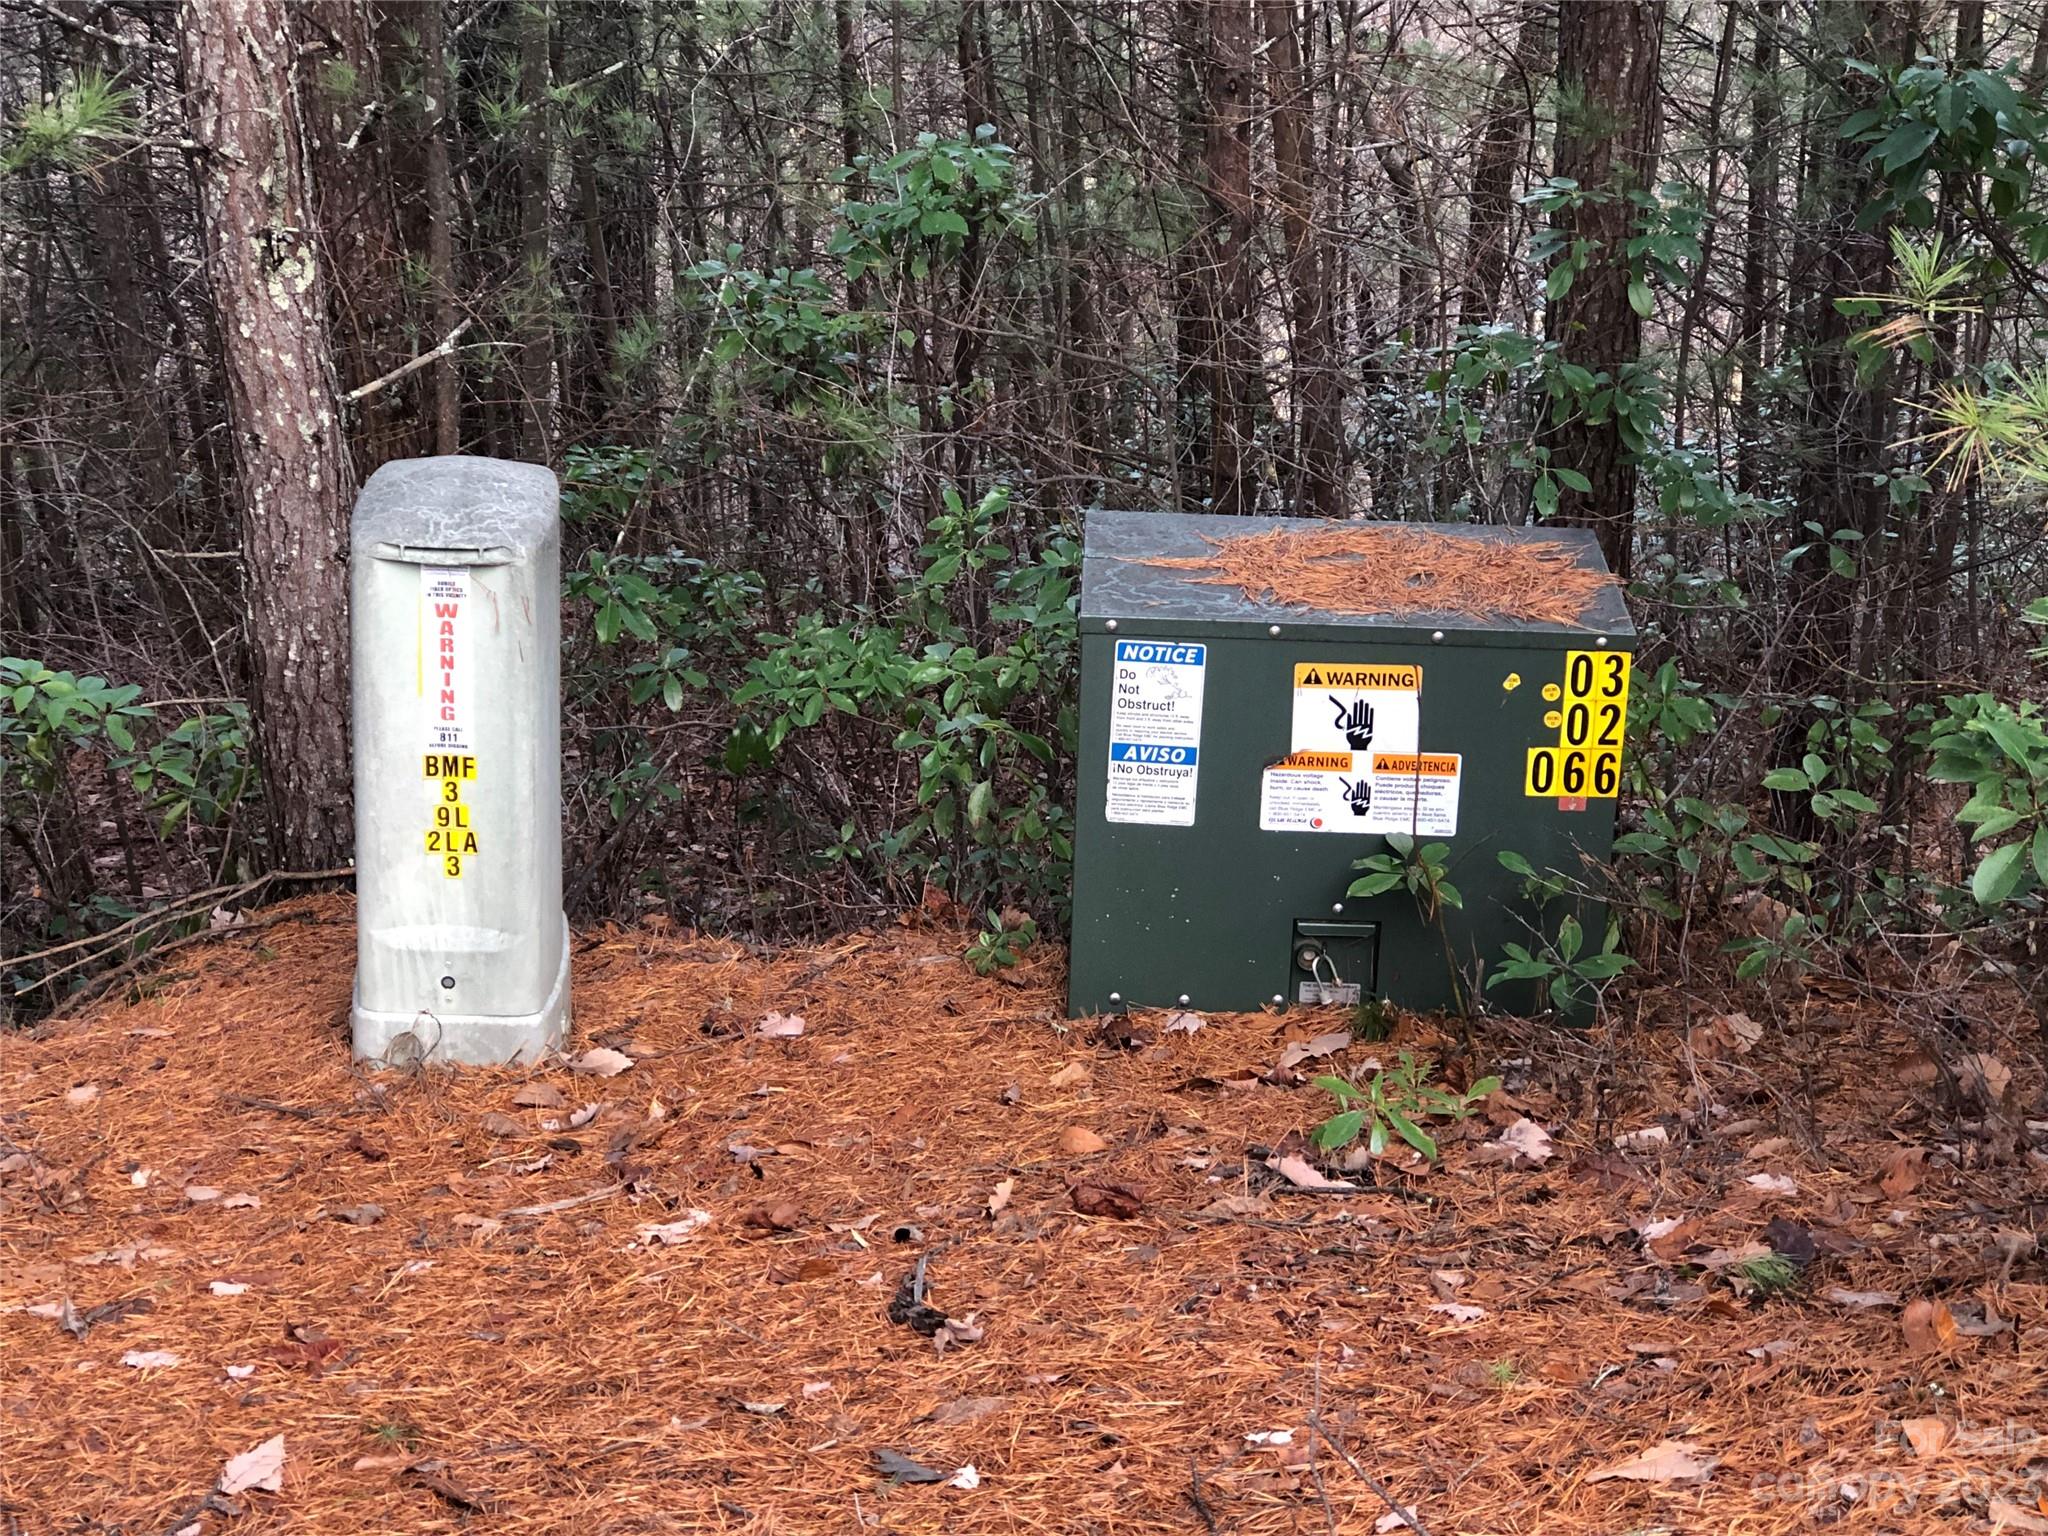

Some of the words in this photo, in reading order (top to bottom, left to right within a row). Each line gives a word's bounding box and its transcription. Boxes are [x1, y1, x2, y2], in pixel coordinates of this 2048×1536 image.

[434, 603, 458, 721] WARNING
[1123, 645, 1198, 664] NOTICE
[1119, 668, 1137, 680] Do
[1326, 671, 1414, 688] WARNING
[1570, 654, 1624, 698] 03
[1118, 683, 1140, 695] Not
[1117, 697, 1176, 712] Obstruct!
[1566, 703, 1622, 746] 02
[439, 732, 458, 742] 811
[1123, 745, 1186, 763] AVISO
[1287, 756, 1349, 769] WARNING
[425, 755, 475, 778] BMF
[1136, 764, 1193, 779] Obstruya!
[1391, 759, 1457, 773] ADVERTENCIA
[1531, 750, 1616, 795] 066
[444, 781, 458, 802] 3
[437, 806, 468, 828] 9L
[427, 830, 478, 853] 2LA
[447, 855, 460, 877] 3
